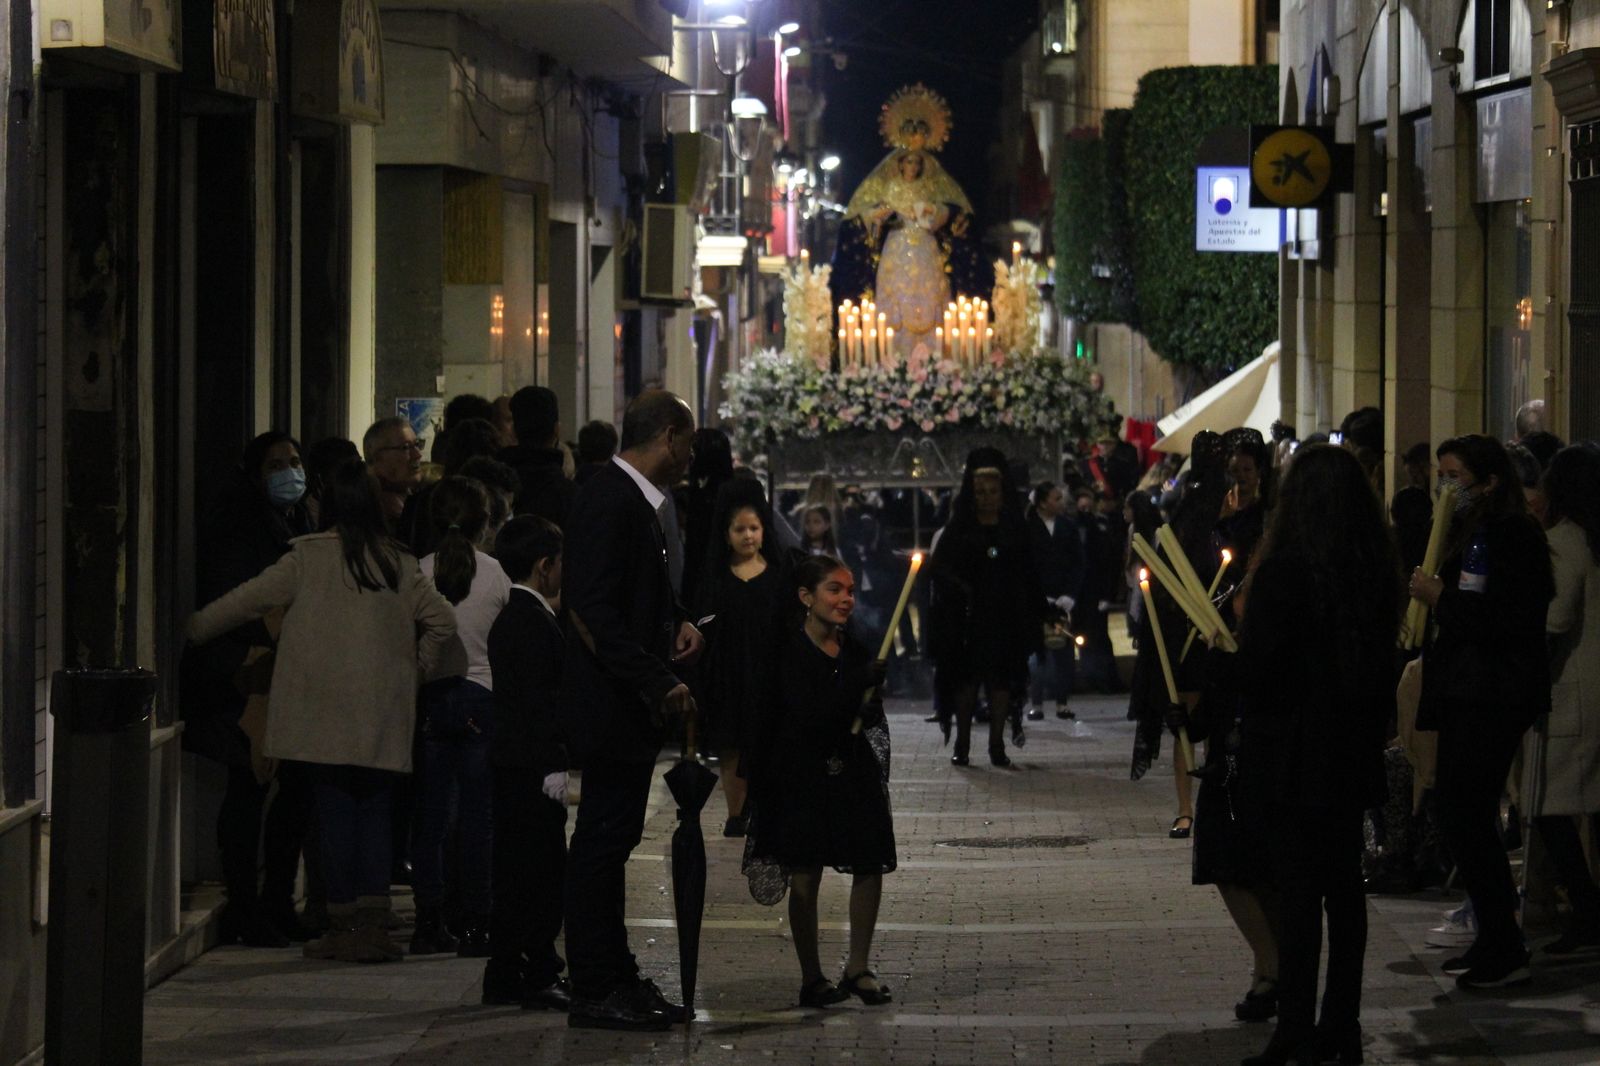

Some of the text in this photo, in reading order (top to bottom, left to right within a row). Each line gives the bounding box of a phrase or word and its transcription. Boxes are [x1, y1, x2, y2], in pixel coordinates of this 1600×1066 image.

[1208, 228, 1262, 237] Apuestas del
[1208, 238, 1236, 246] Estado
